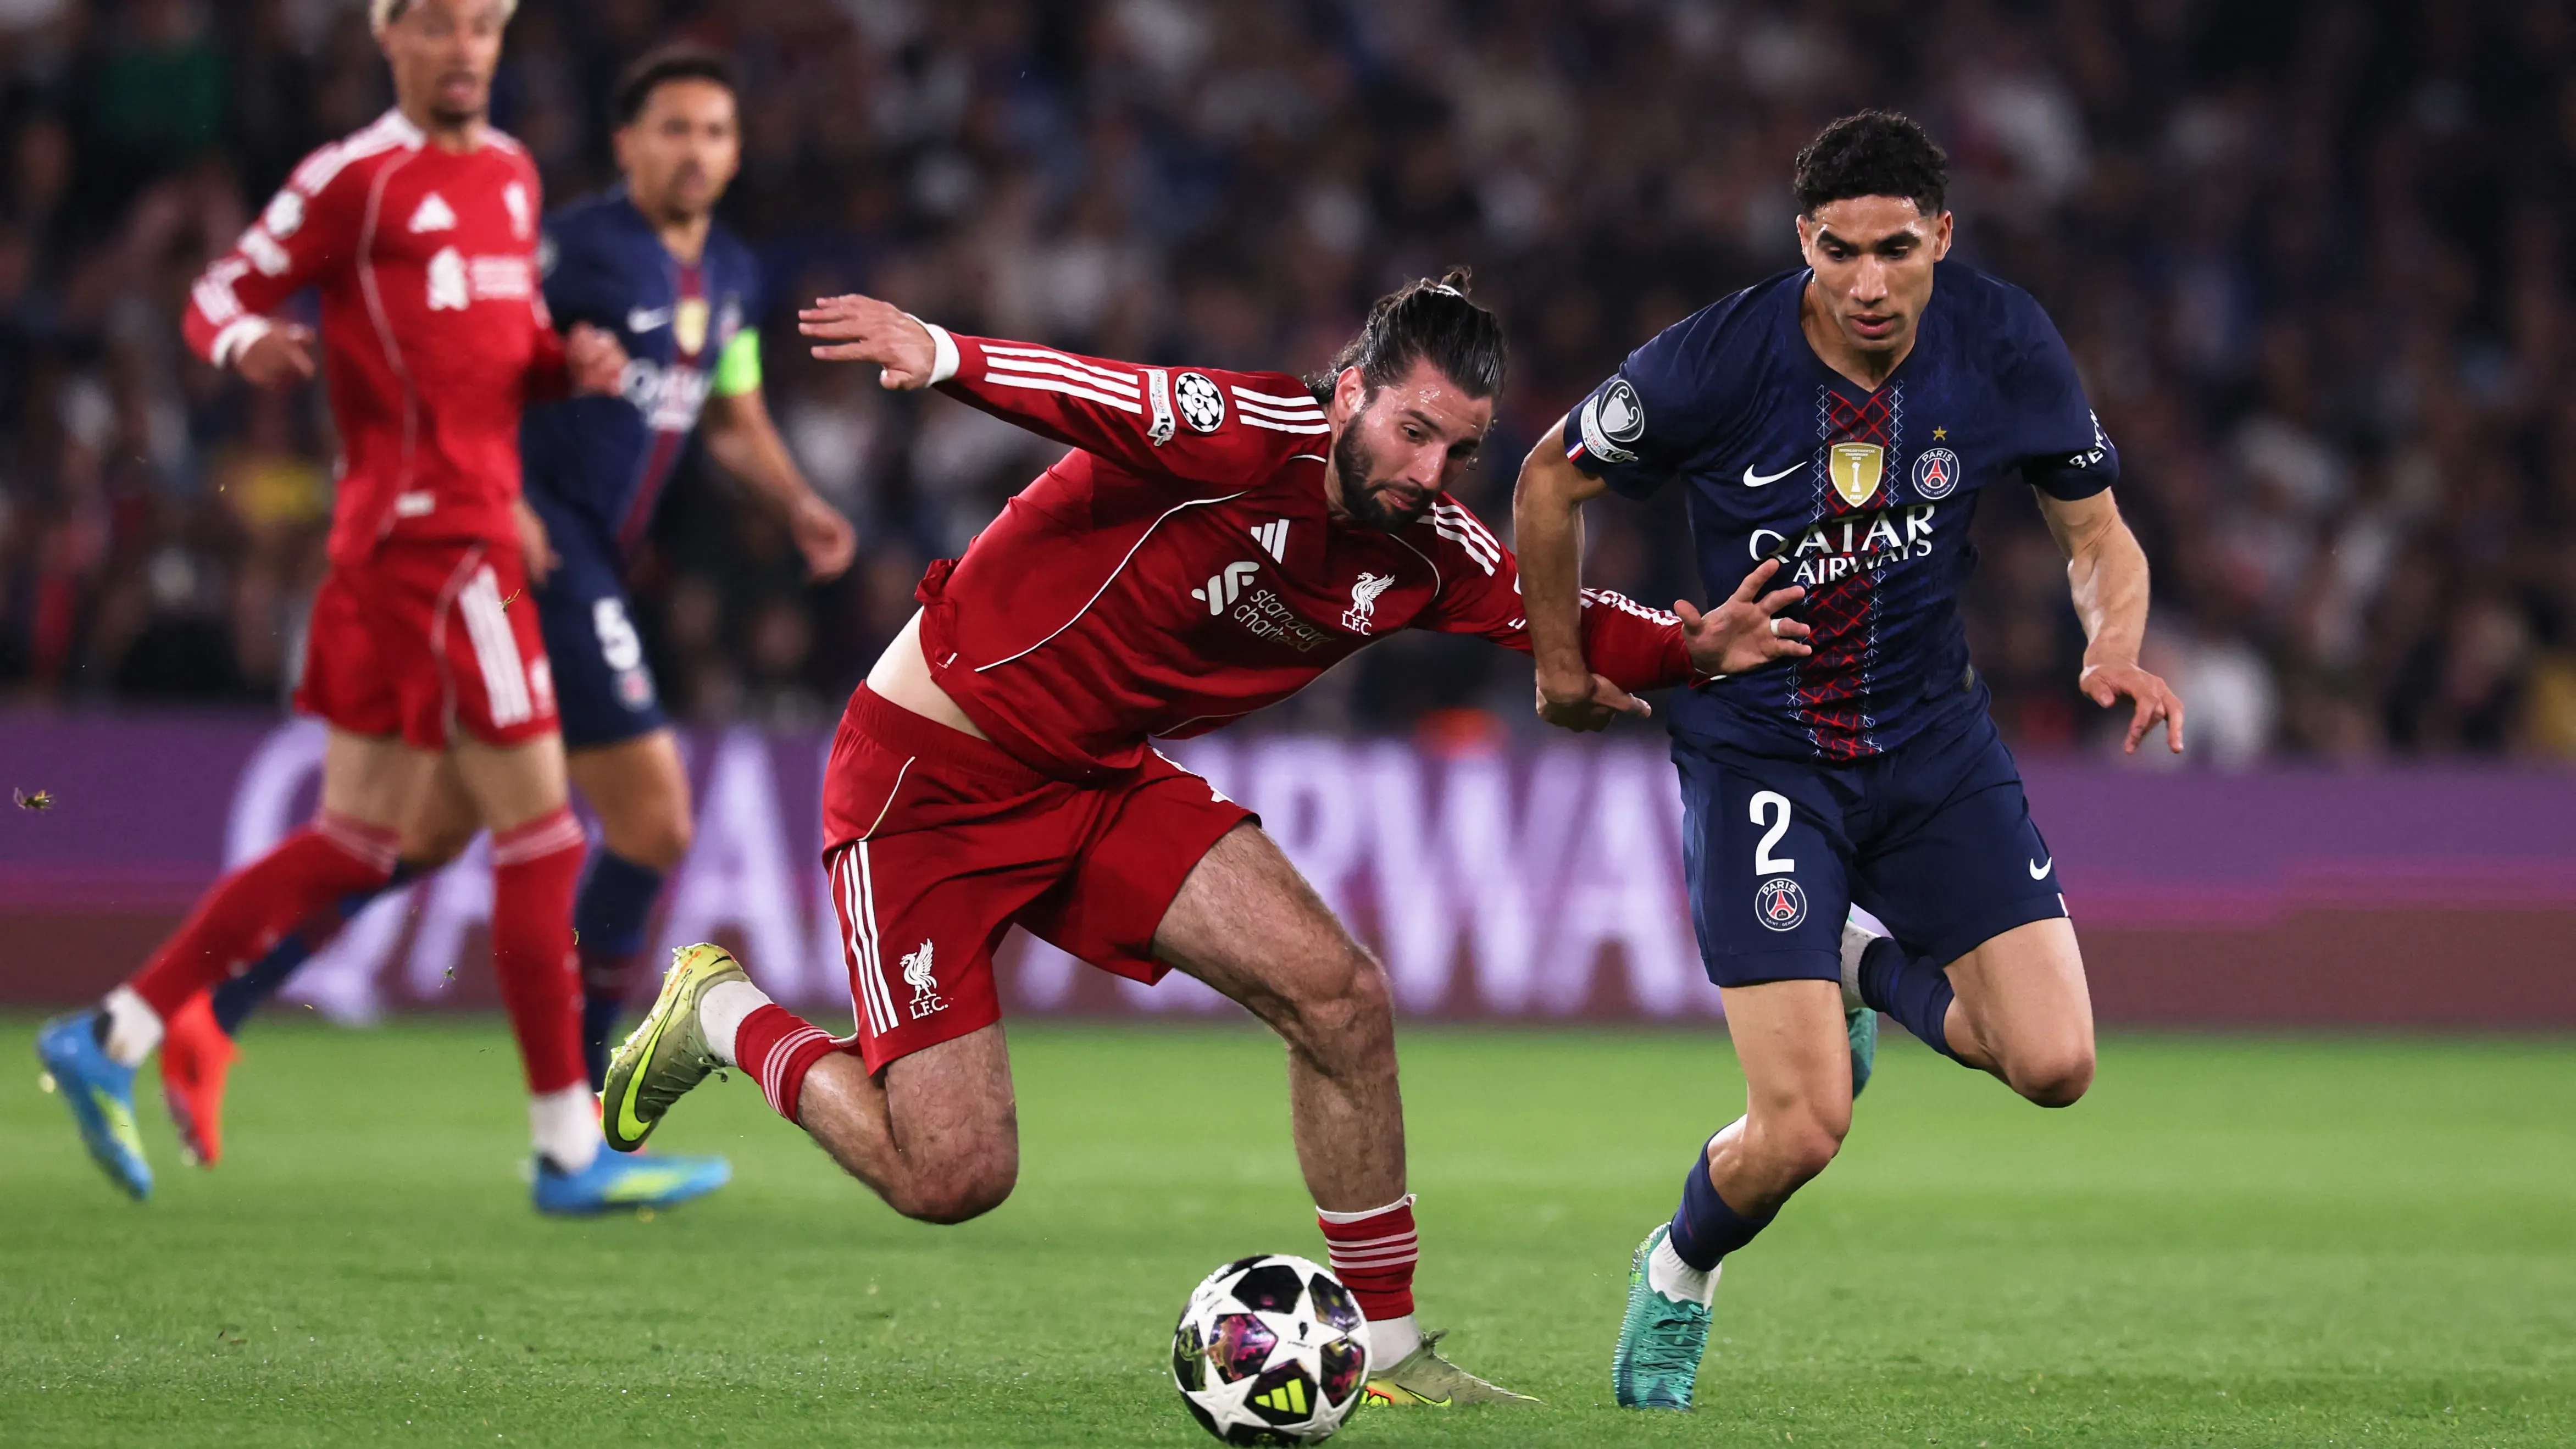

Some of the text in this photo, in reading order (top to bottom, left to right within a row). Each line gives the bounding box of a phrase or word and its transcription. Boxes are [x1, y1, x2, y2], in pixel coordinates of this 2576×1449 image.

[1922, 450, 1953, 463] PARIS
[1749, 503, 1935, 564] QATAR
[1792, 538, 1933, 584] AIRWAYS
[591, 597, 641, 672] 5
[1749, 790, 1795, 876] 2
[1762, 880, 1797, 896] PARIS
[909, 996, 949, 1020] L.F.C.
